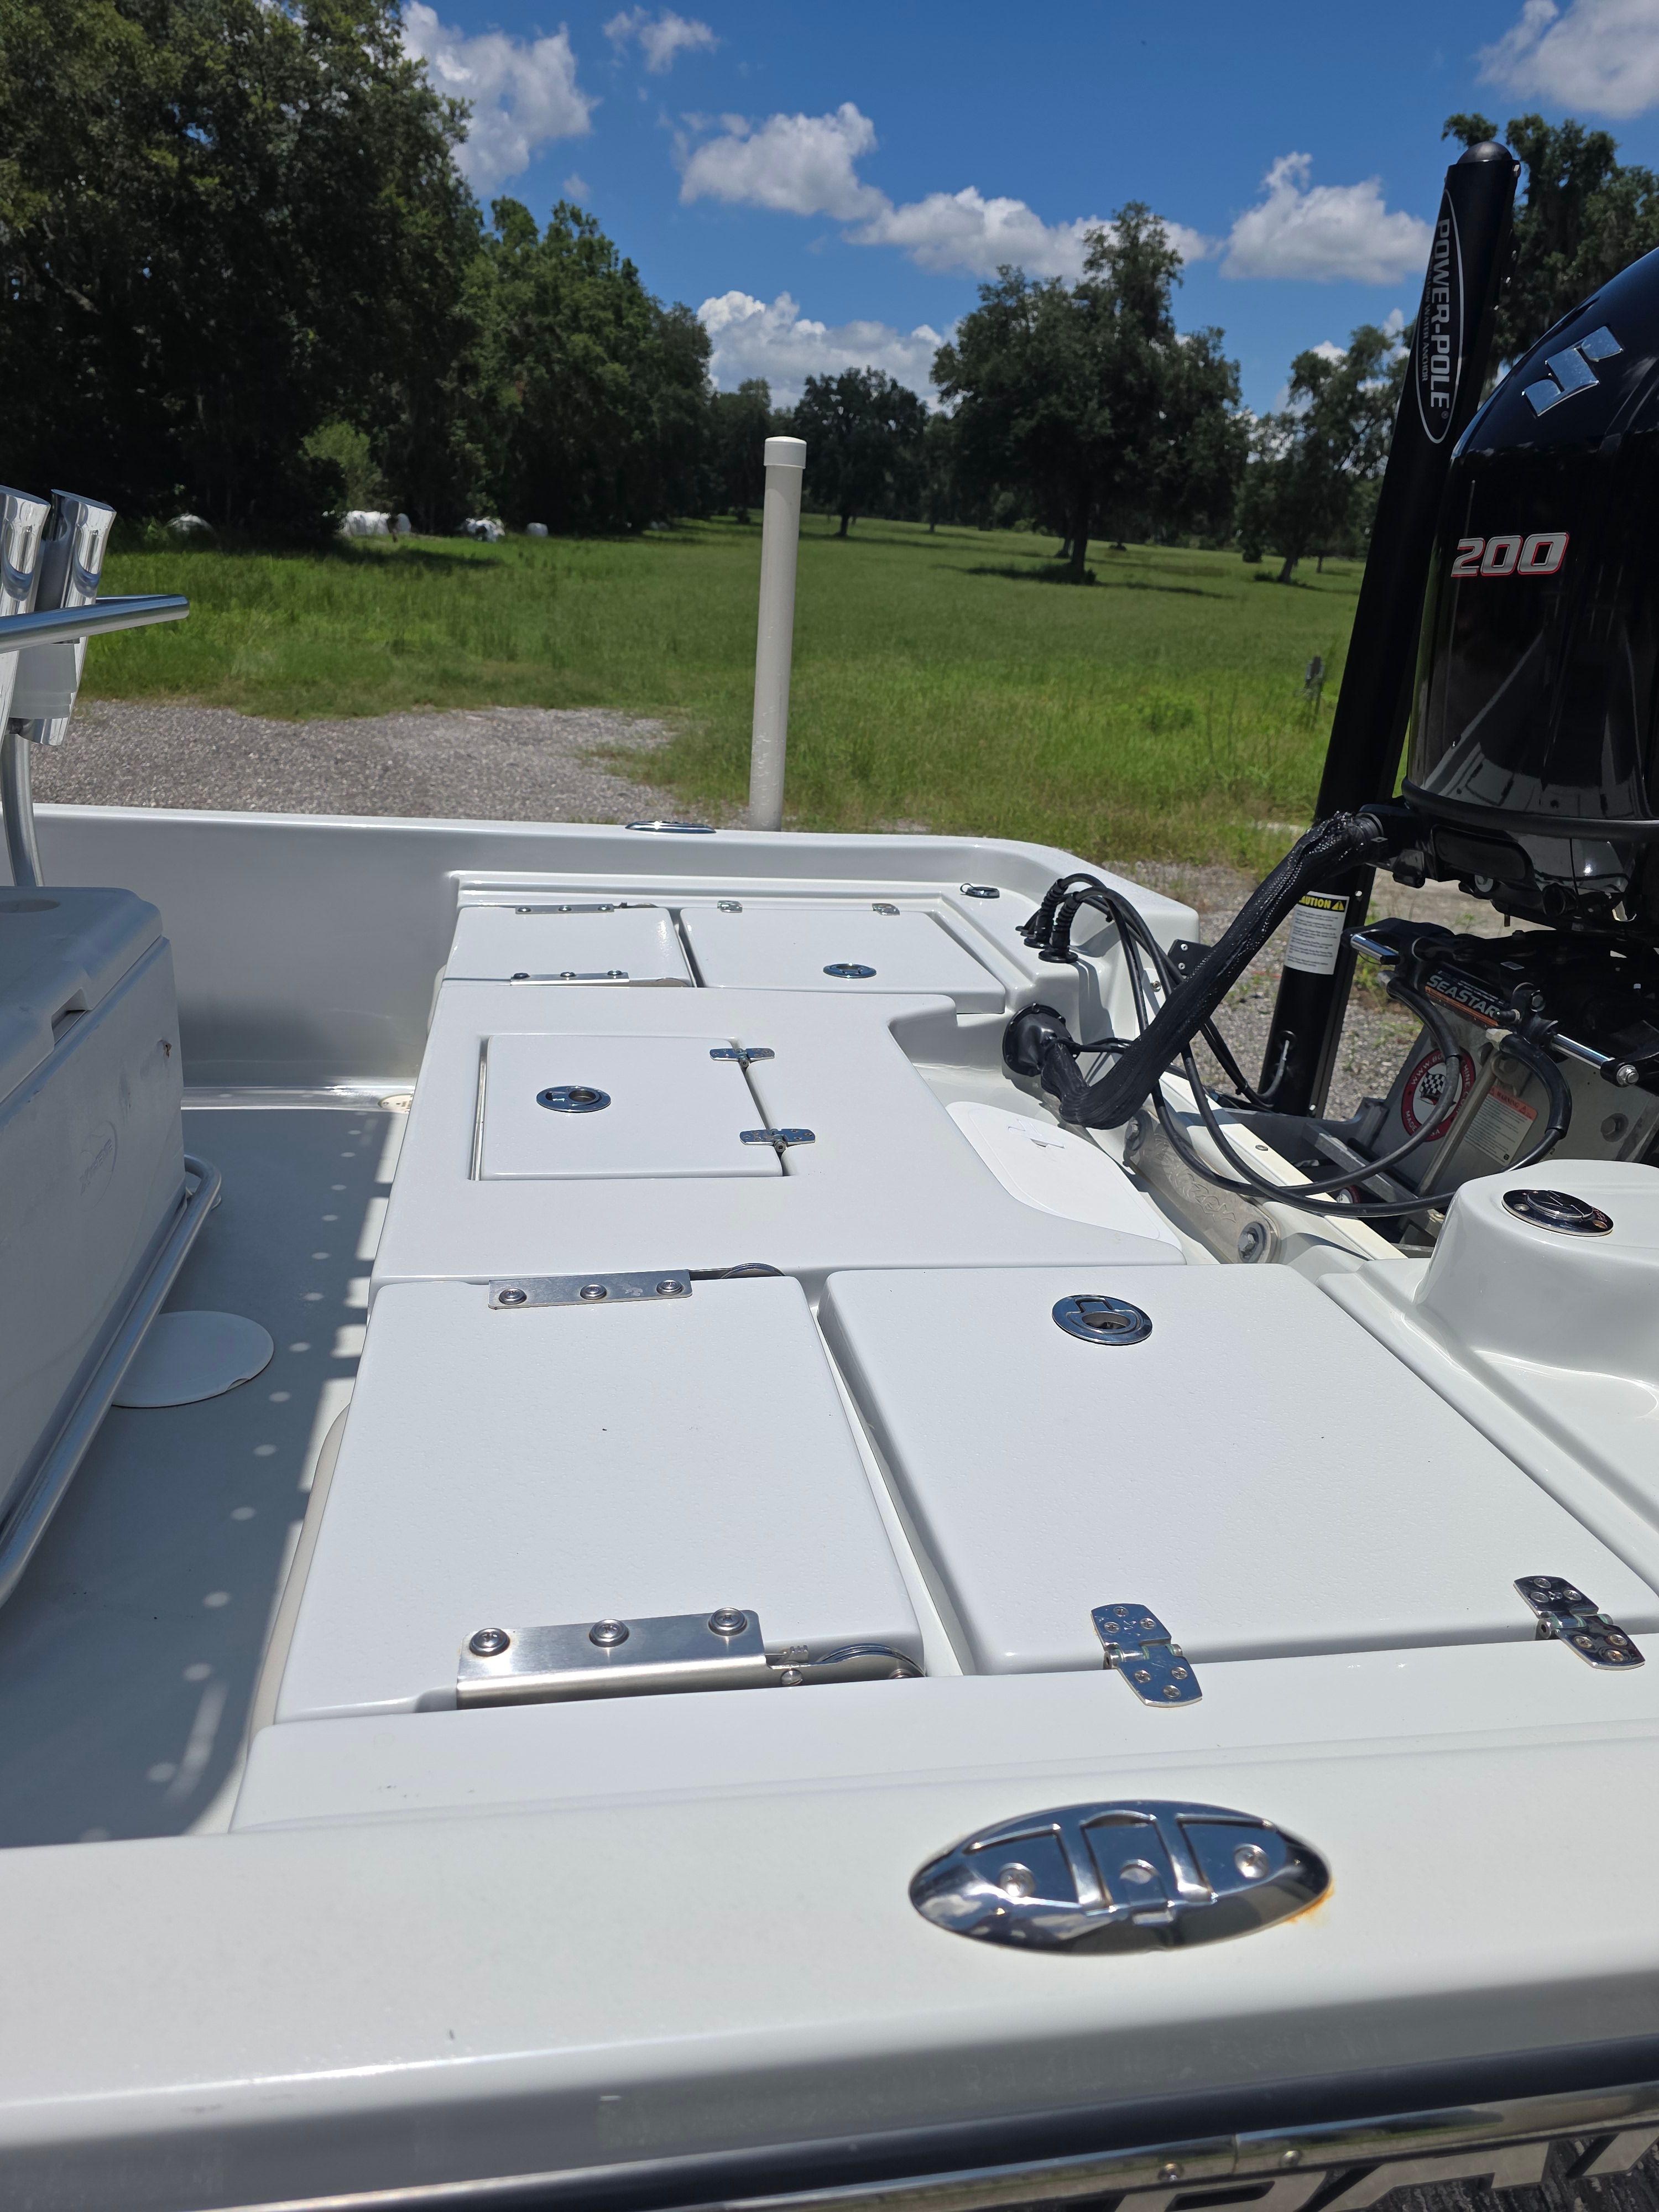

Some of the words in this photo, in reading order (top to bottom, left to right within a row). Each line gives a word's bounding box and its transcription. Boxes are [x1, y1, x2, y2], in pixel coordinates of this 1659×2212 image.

[1431, 219, 1450, 408] POWER-POLE
[1451, 531, 1569, 577] 200
[1299, 895, 1332, 909] AUTION
[1426, 975, 1500, 1018] SEASTAR
